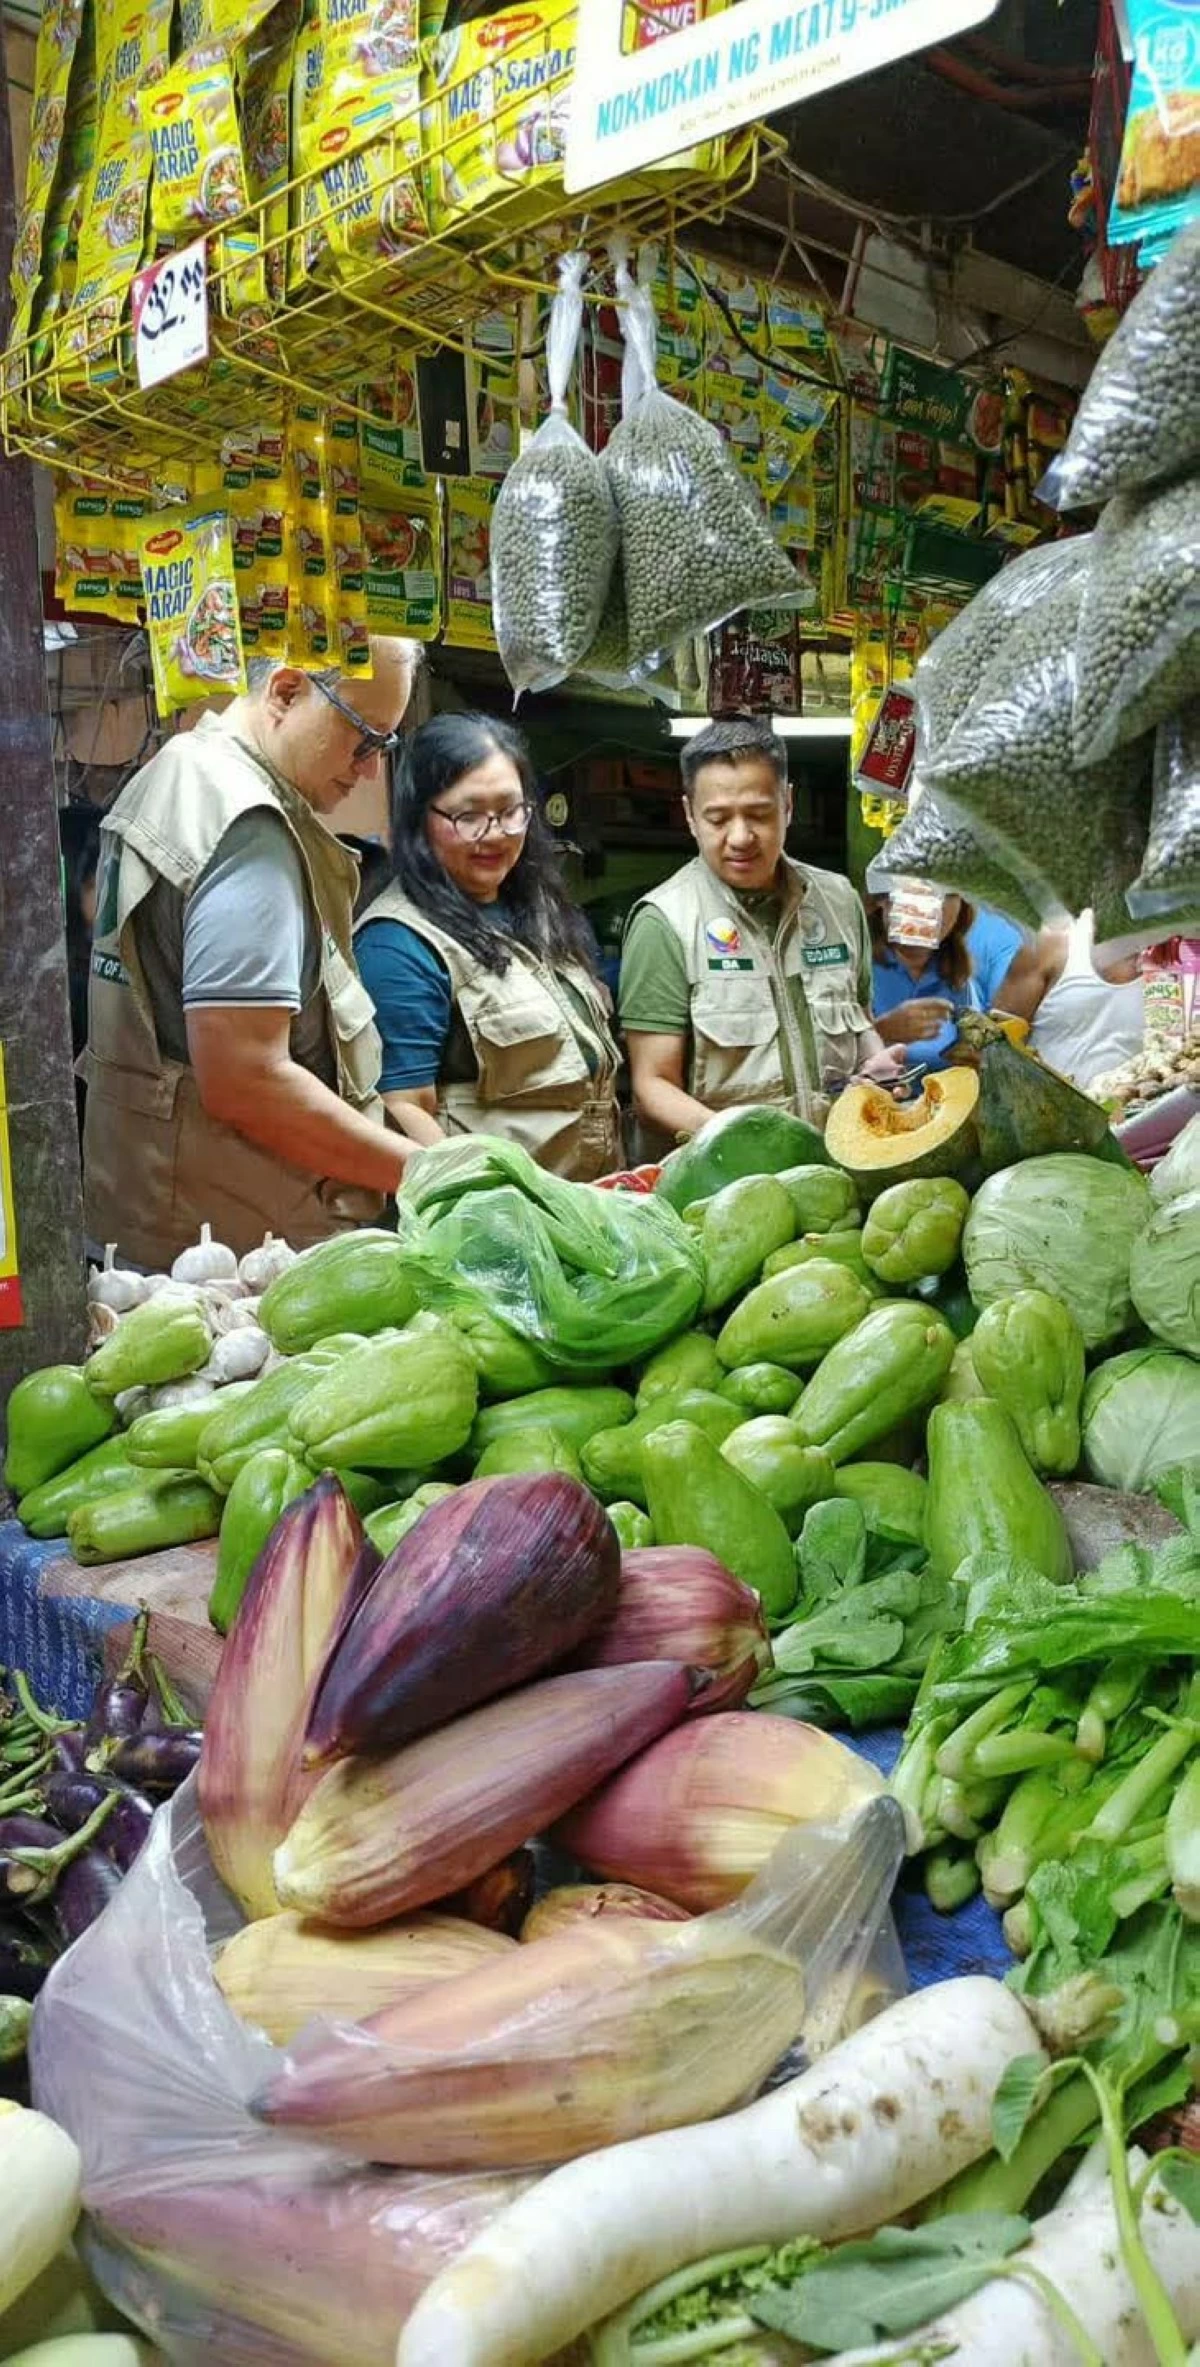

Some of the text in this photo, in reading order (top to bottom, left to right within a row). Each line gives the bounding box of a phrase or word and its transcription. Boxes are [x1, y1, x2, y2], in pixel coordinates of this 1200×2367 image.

[597, 53, 718, 141] NOKNOKAN
[728, 33, 759, 83] NG
[157, 147, 199, 183] ARAP
[151, 586, 192, 621] ARAP
[104, 960, 120, 976] OF
[722, 959, 741, 970] DA
